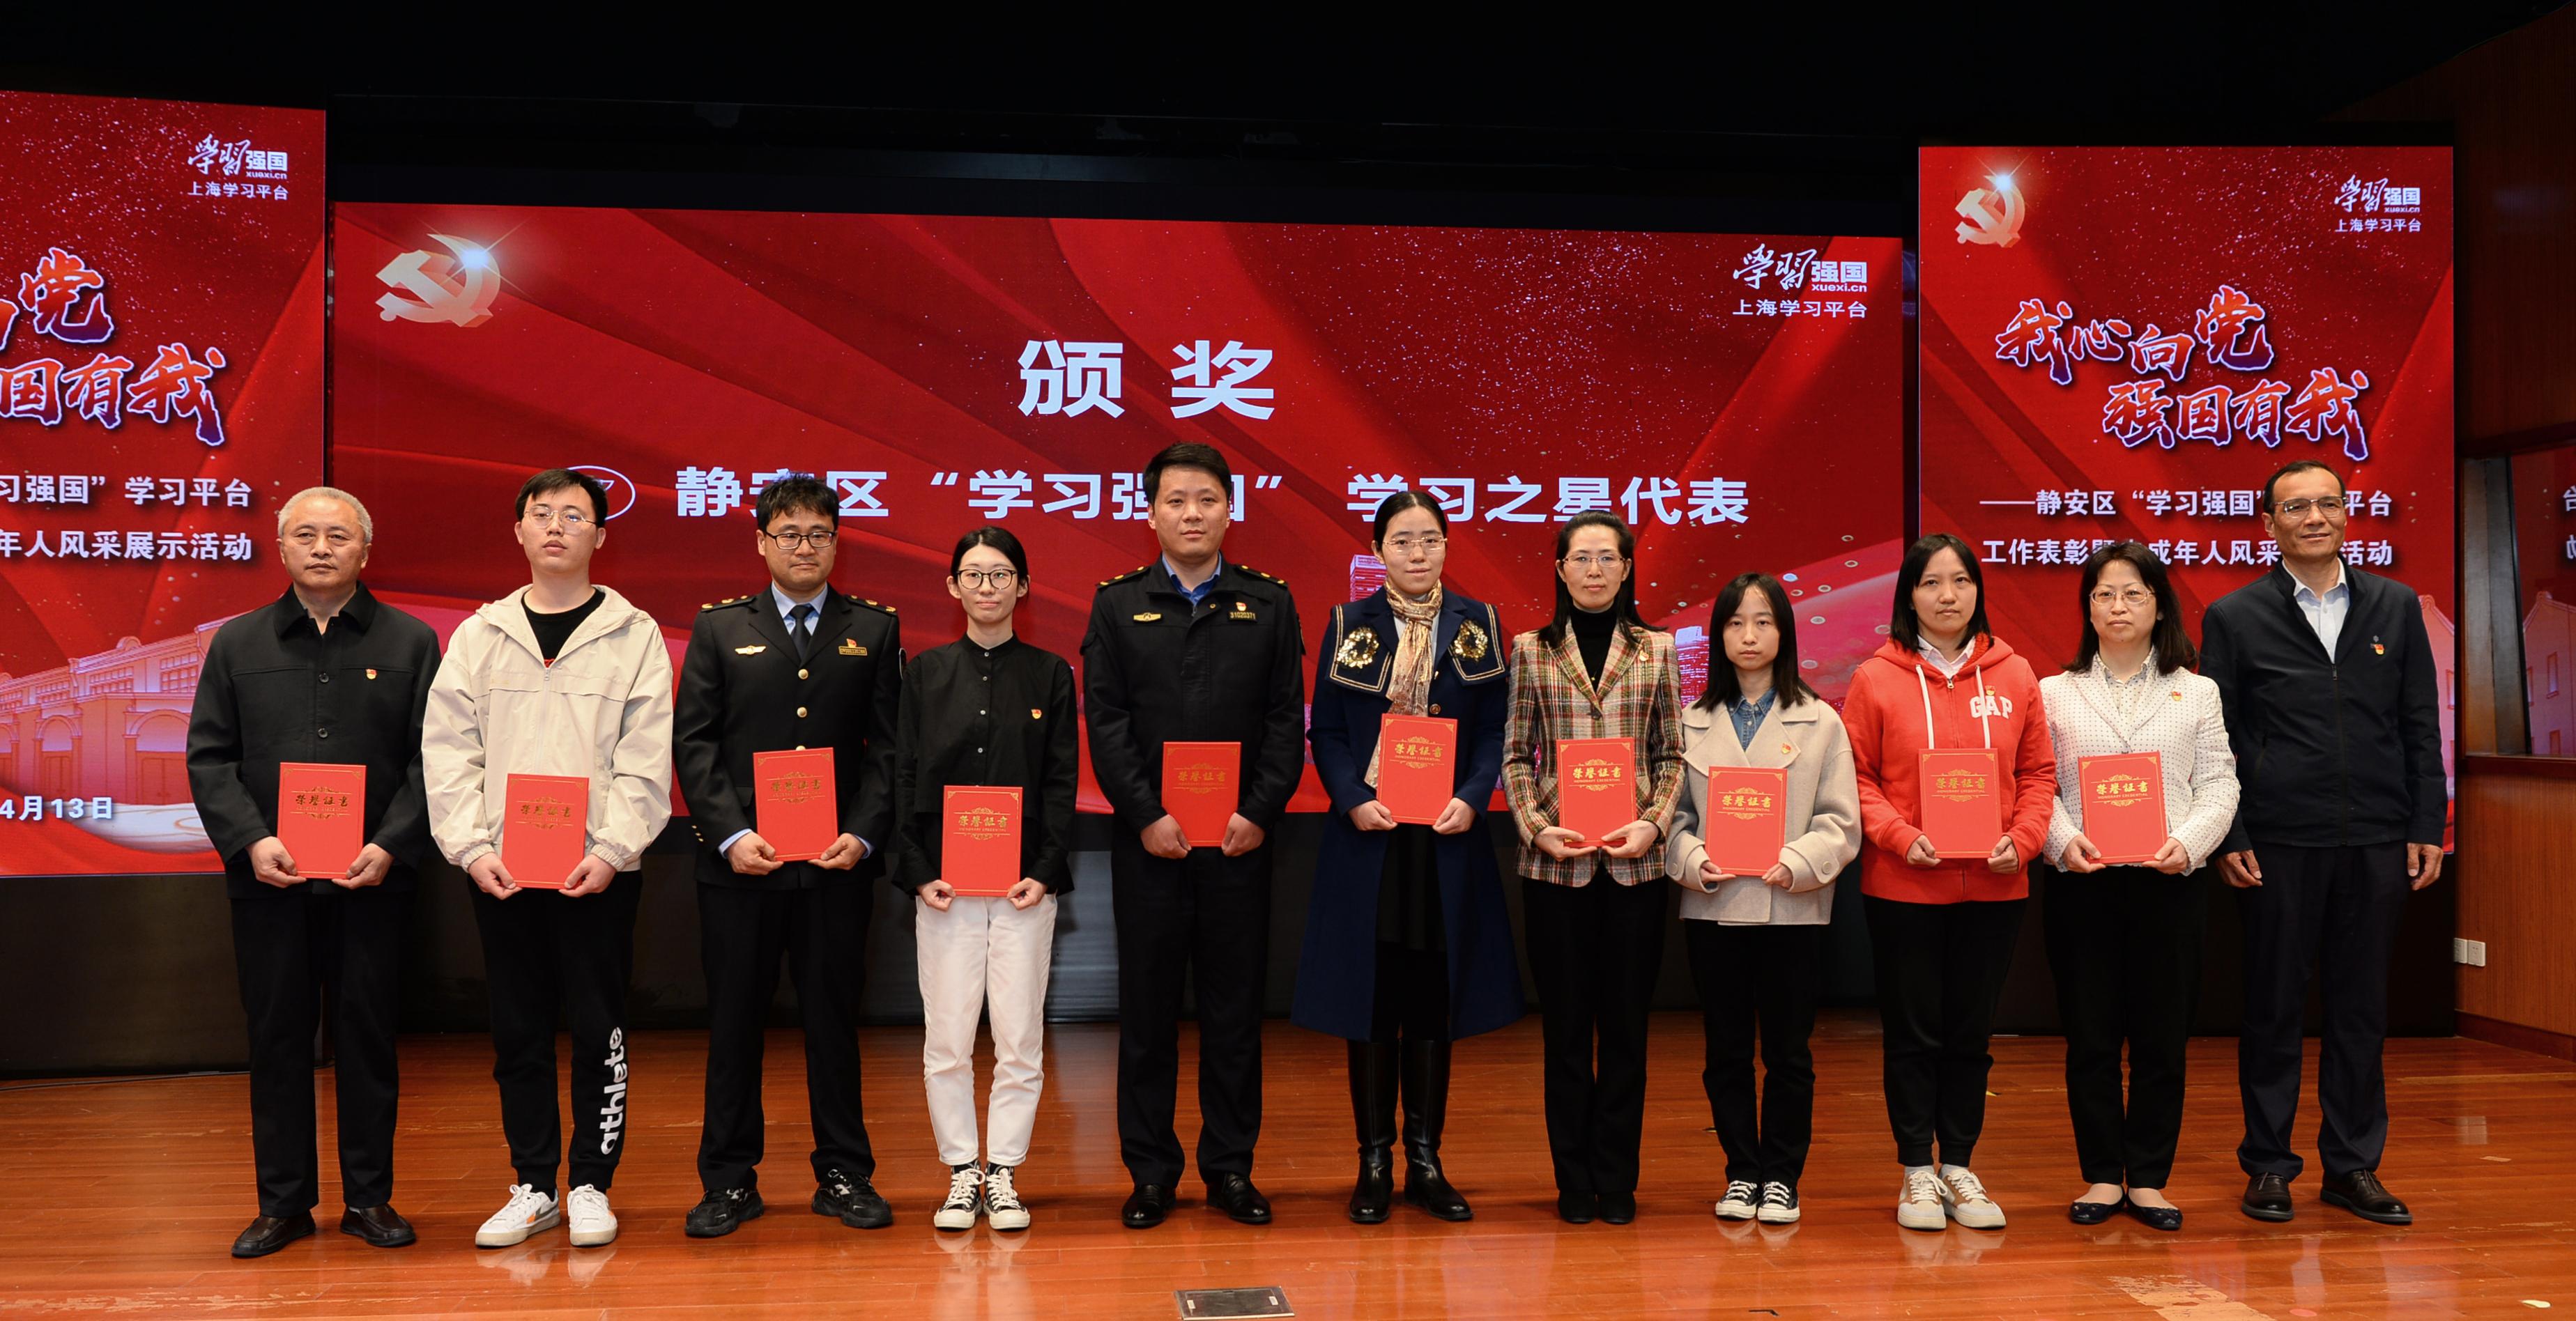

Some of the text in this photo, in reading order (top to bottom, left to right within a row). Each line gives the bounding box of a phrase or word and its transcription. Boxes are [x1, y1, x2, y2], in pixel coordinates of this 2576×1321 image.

[187, 180, 289, 201] 上海学习平台
[2334, 217, 2421, 233] 上海学习平台
[1811, 283, 1868, 292] xuexi.cn
[1732, 299, 1868, 318] 上海学习平台
[1995, 285, 2274, 385] 我心向党
[1018, 339, 1275, 420] 颁奖
[0, 343, 227, 446] 国有我
[2103, 367, 2369, 461] 强国有我
[0, 529, 252, 560] 年人风采展示活动
[1970, 695, 2013, 719] GAP
[0, 796, 112, 821] 4月13日
[599, 1027, 627, 1155] athlete
